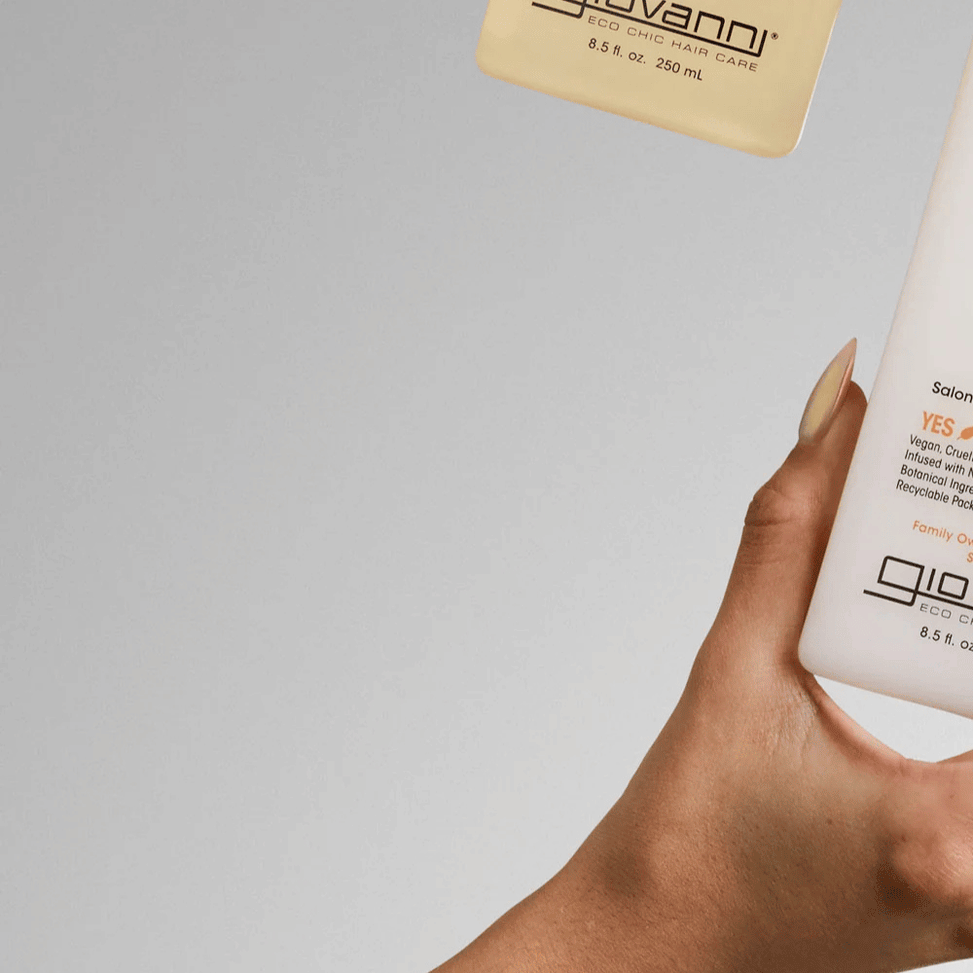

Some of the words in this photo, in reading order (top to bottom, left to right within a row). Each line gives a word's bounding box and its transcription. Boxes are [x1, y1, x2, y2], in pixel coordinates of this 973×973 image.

[587, 15, 620, 31] ECO
[627, 27, 664, 45] CHIC
[671, 40, 709, 57] HAIR
[715, 52, 758, 72] CARE
[588, 37, 609, 53] 8.5
[613, 44, 623, 58] fl.
[628, 51, 646, 64] oz.
[655, 57, 681, 74] 250
[683, 67, 703, 81] mL
[922, 410, 955, 437] YES
[910, 434, 942, 454] Vegan,
[904, 449, 943, 469] Infused
[945, 462, 965, 476] with
[900, 464, 948, 487] Botanical
[896, 478, 950, 504] Recyclable
[912, 520, 954, 542] Family
[919, 603, 952, 619] ECO
[919, 626, 941, 642] 8.5
[944, 633, 954, 646] fl.
